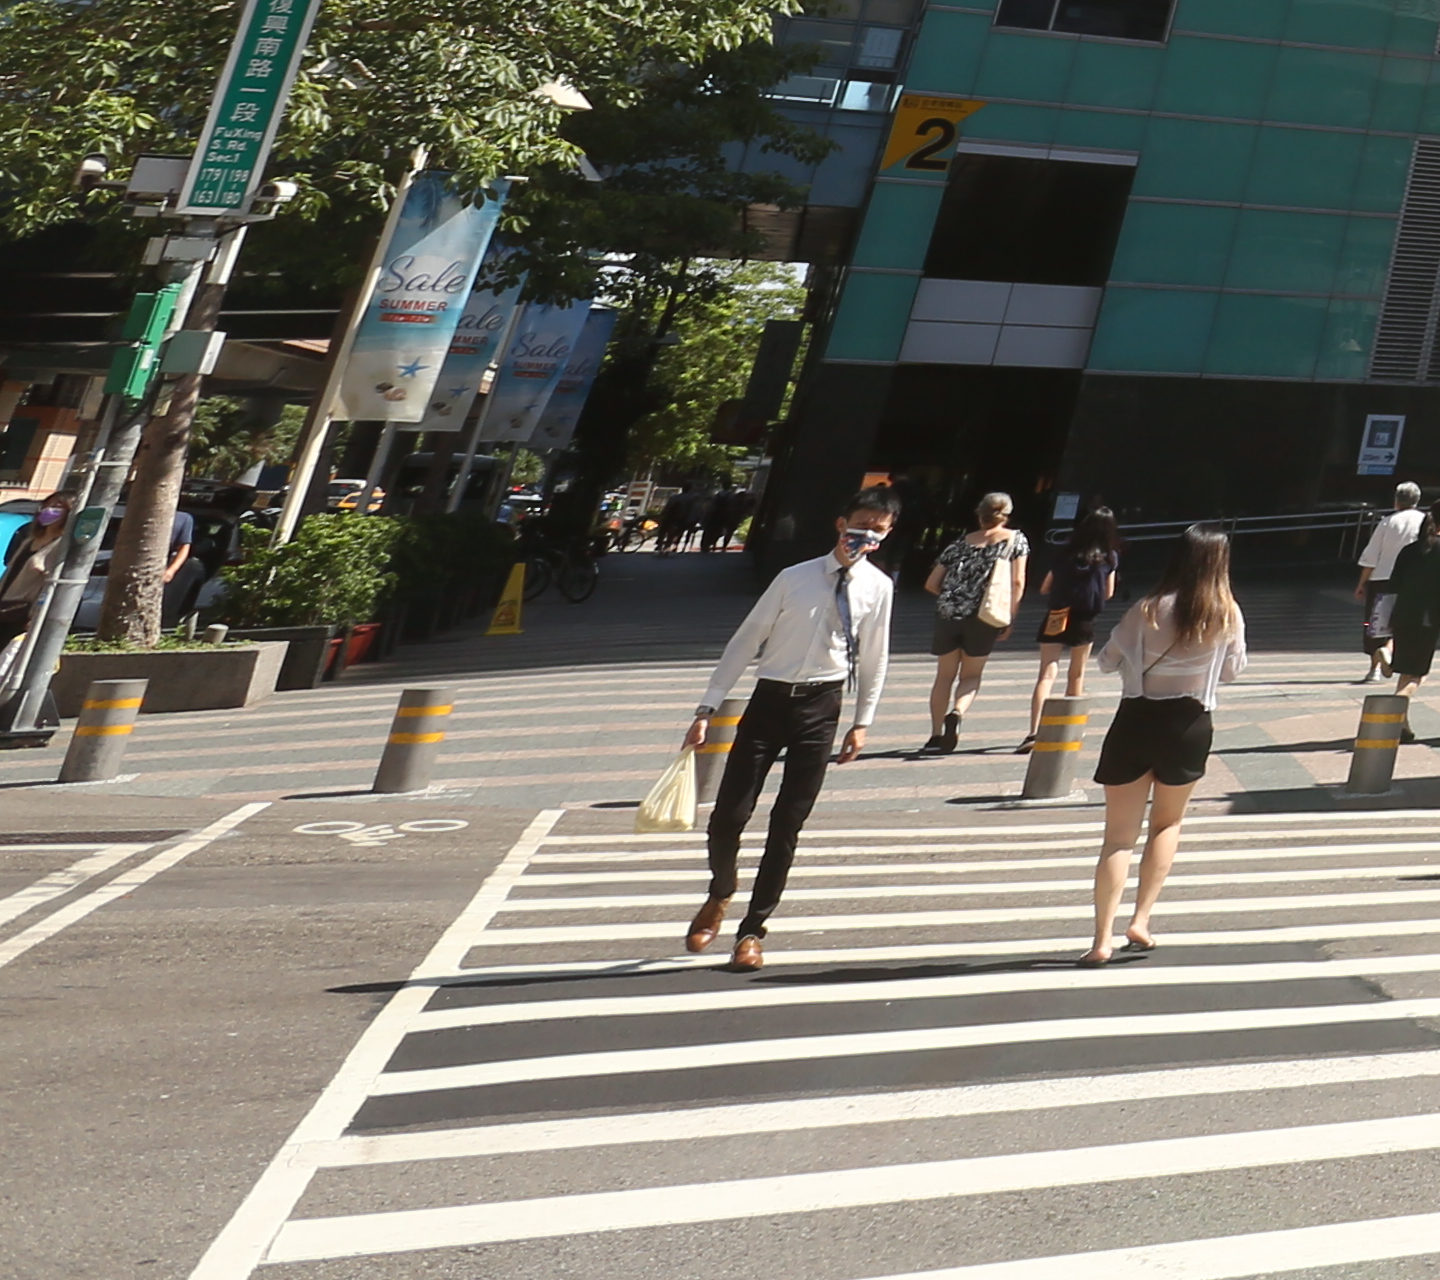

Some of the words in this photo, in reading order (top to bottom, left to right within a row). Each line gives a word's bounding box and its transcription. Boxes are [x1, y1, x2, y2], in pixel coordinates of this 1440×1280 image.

[213, 126, 264, 143] FuXing
[210, 139, 224, 150] S.
[226, 139, 248, 152] Rd.
[904, 117, 956, 171] 2
[205, 151, 241, 164] Sec.1
[201, 167, 221, 182] 179
[376, 254, 469, 294] Sale
[378, 297, 449, 313] SUMMER
[456, 304, 504, 331] ale
[453, 335, 490, 347] MMER
[510, 332, 571, 359] Sale
